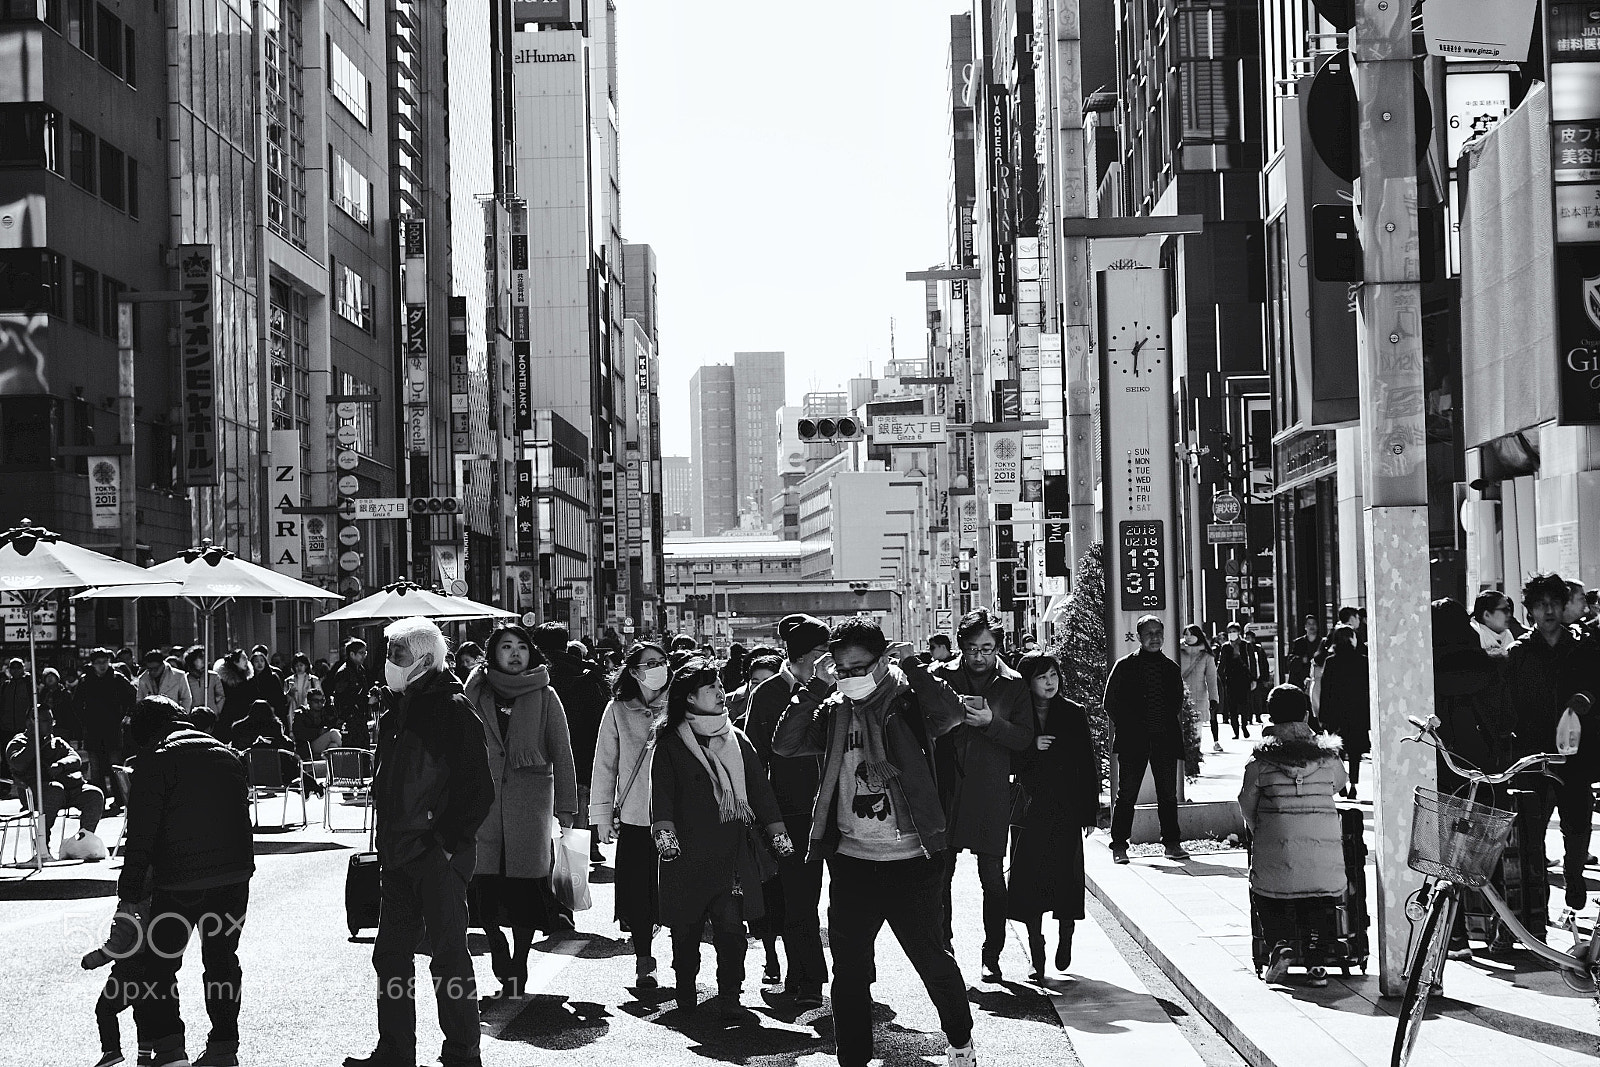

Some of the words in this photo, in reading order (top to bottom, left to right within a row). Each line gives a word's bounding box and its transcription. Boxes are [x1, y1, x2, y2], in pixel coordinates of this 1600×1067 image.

[1450, 115, 1460, 129] 6
[409, 309, 425, 351] ダンス
[1567, 348, 1599, 371] Gi
[518, 354, 528, 410] MONTBLANC
[411, 381, 424, 401] Dr.
[411, 408, 425, 451] Recella
[878, 421, 941, 435] 銀座六丁目
[1134, 448, 1150, 456] SUN
[994, 472, 1016, 480] 2018
[1135, 476, 1151, 484] WED
[95, 495, 116, 504] 2018
[519, 472, 531, 532] 日新堂
[1136, 494, 1150, 502] FRI
[359, 503, 405, 513] 銀座六丁目
[1136, 504, 1152, 512] SAT
[1215, 503, 1238, 514] 消火栓
[274, 465, 298, 565] ZARA
[1126, 525, 1156, 536] 2018
[309, 542, 325, 550] 2018
[1125, 537, 1158, 546] 02.18
[1127, 549, 1160, 570] 13
[1126, 572, 1155, 594] 31
[1125, 631, 1135, 642] 交
